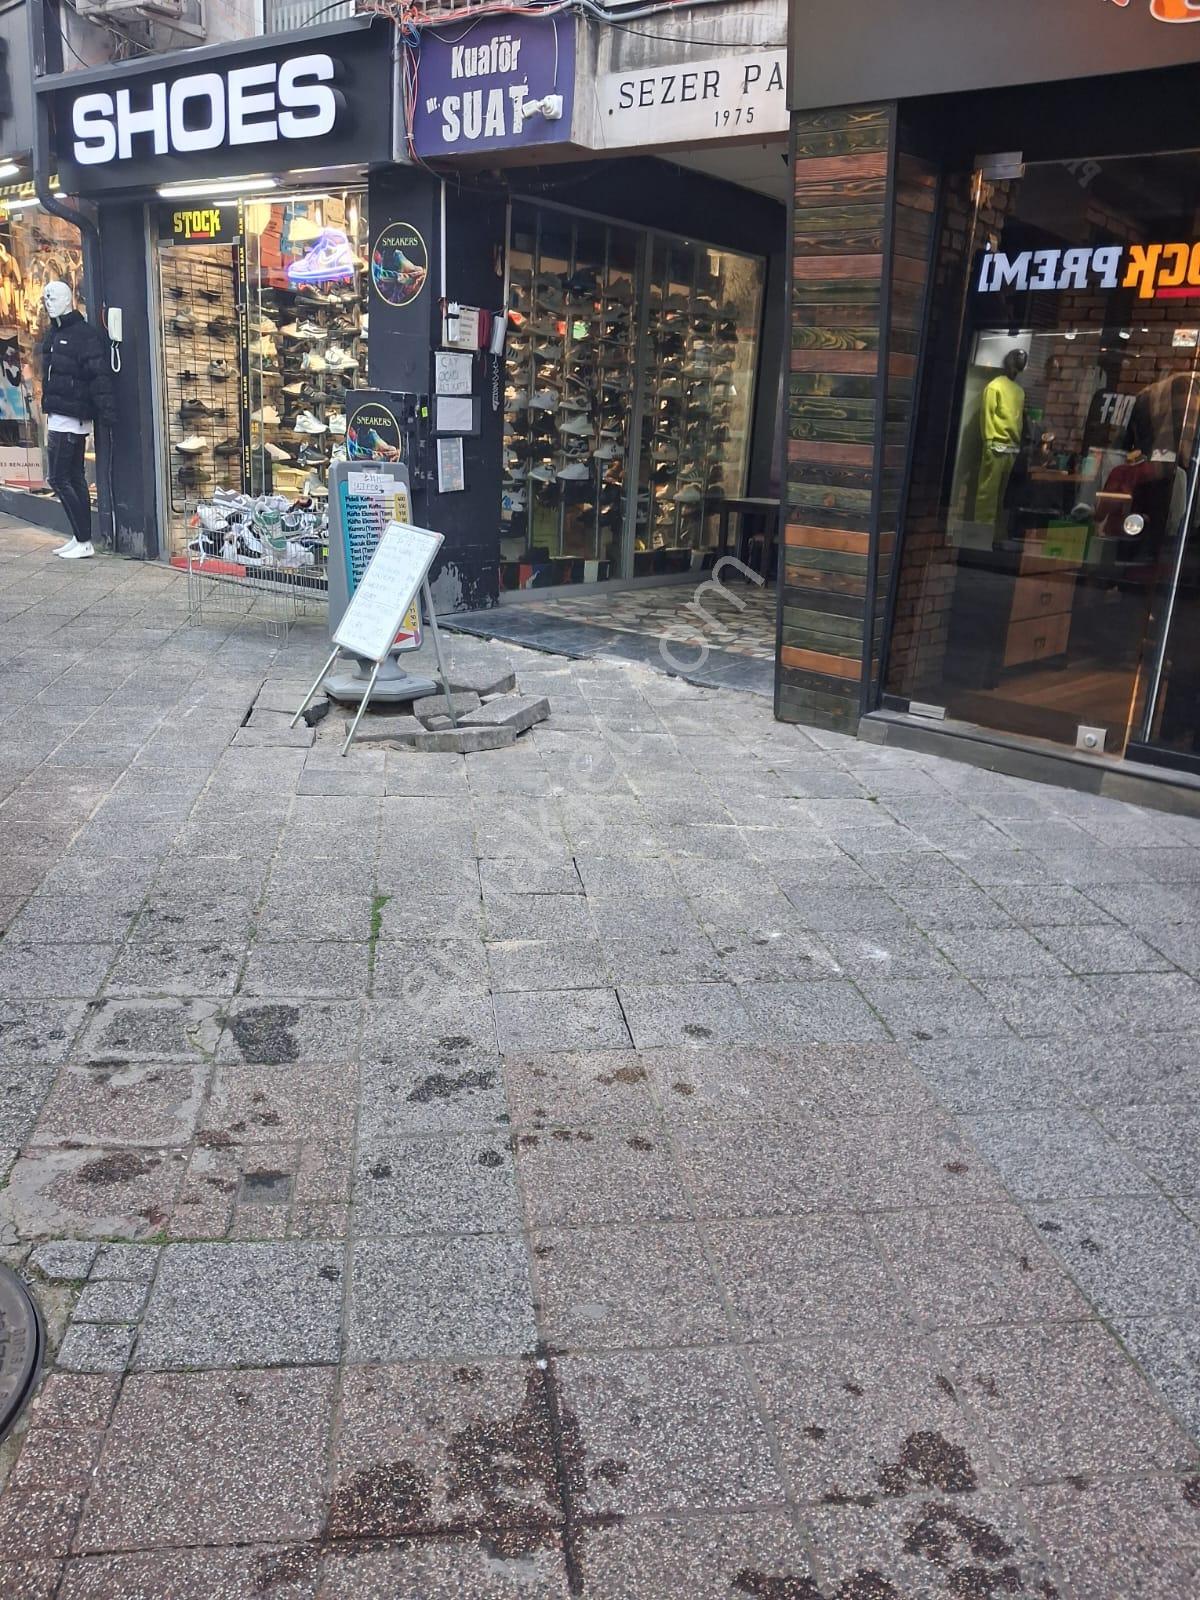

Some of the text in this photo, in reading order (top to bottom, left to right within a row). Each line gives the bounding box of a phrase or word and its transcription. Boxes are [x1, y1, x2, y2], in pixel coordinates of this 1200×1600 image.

[451, 35, 521, 79] Kuaför
[619, 70, 721, 109] SEZER
[72, 53, 337, 165] SHOES
[441, 84, 529, 142] SUAT
[714, 107, 755, 127] 1975
[173, 208, 221, 239] STOCK
[382, 237, 418, 246] SNEAKERS
[356, 415, 392, 427] SNEAKERS
